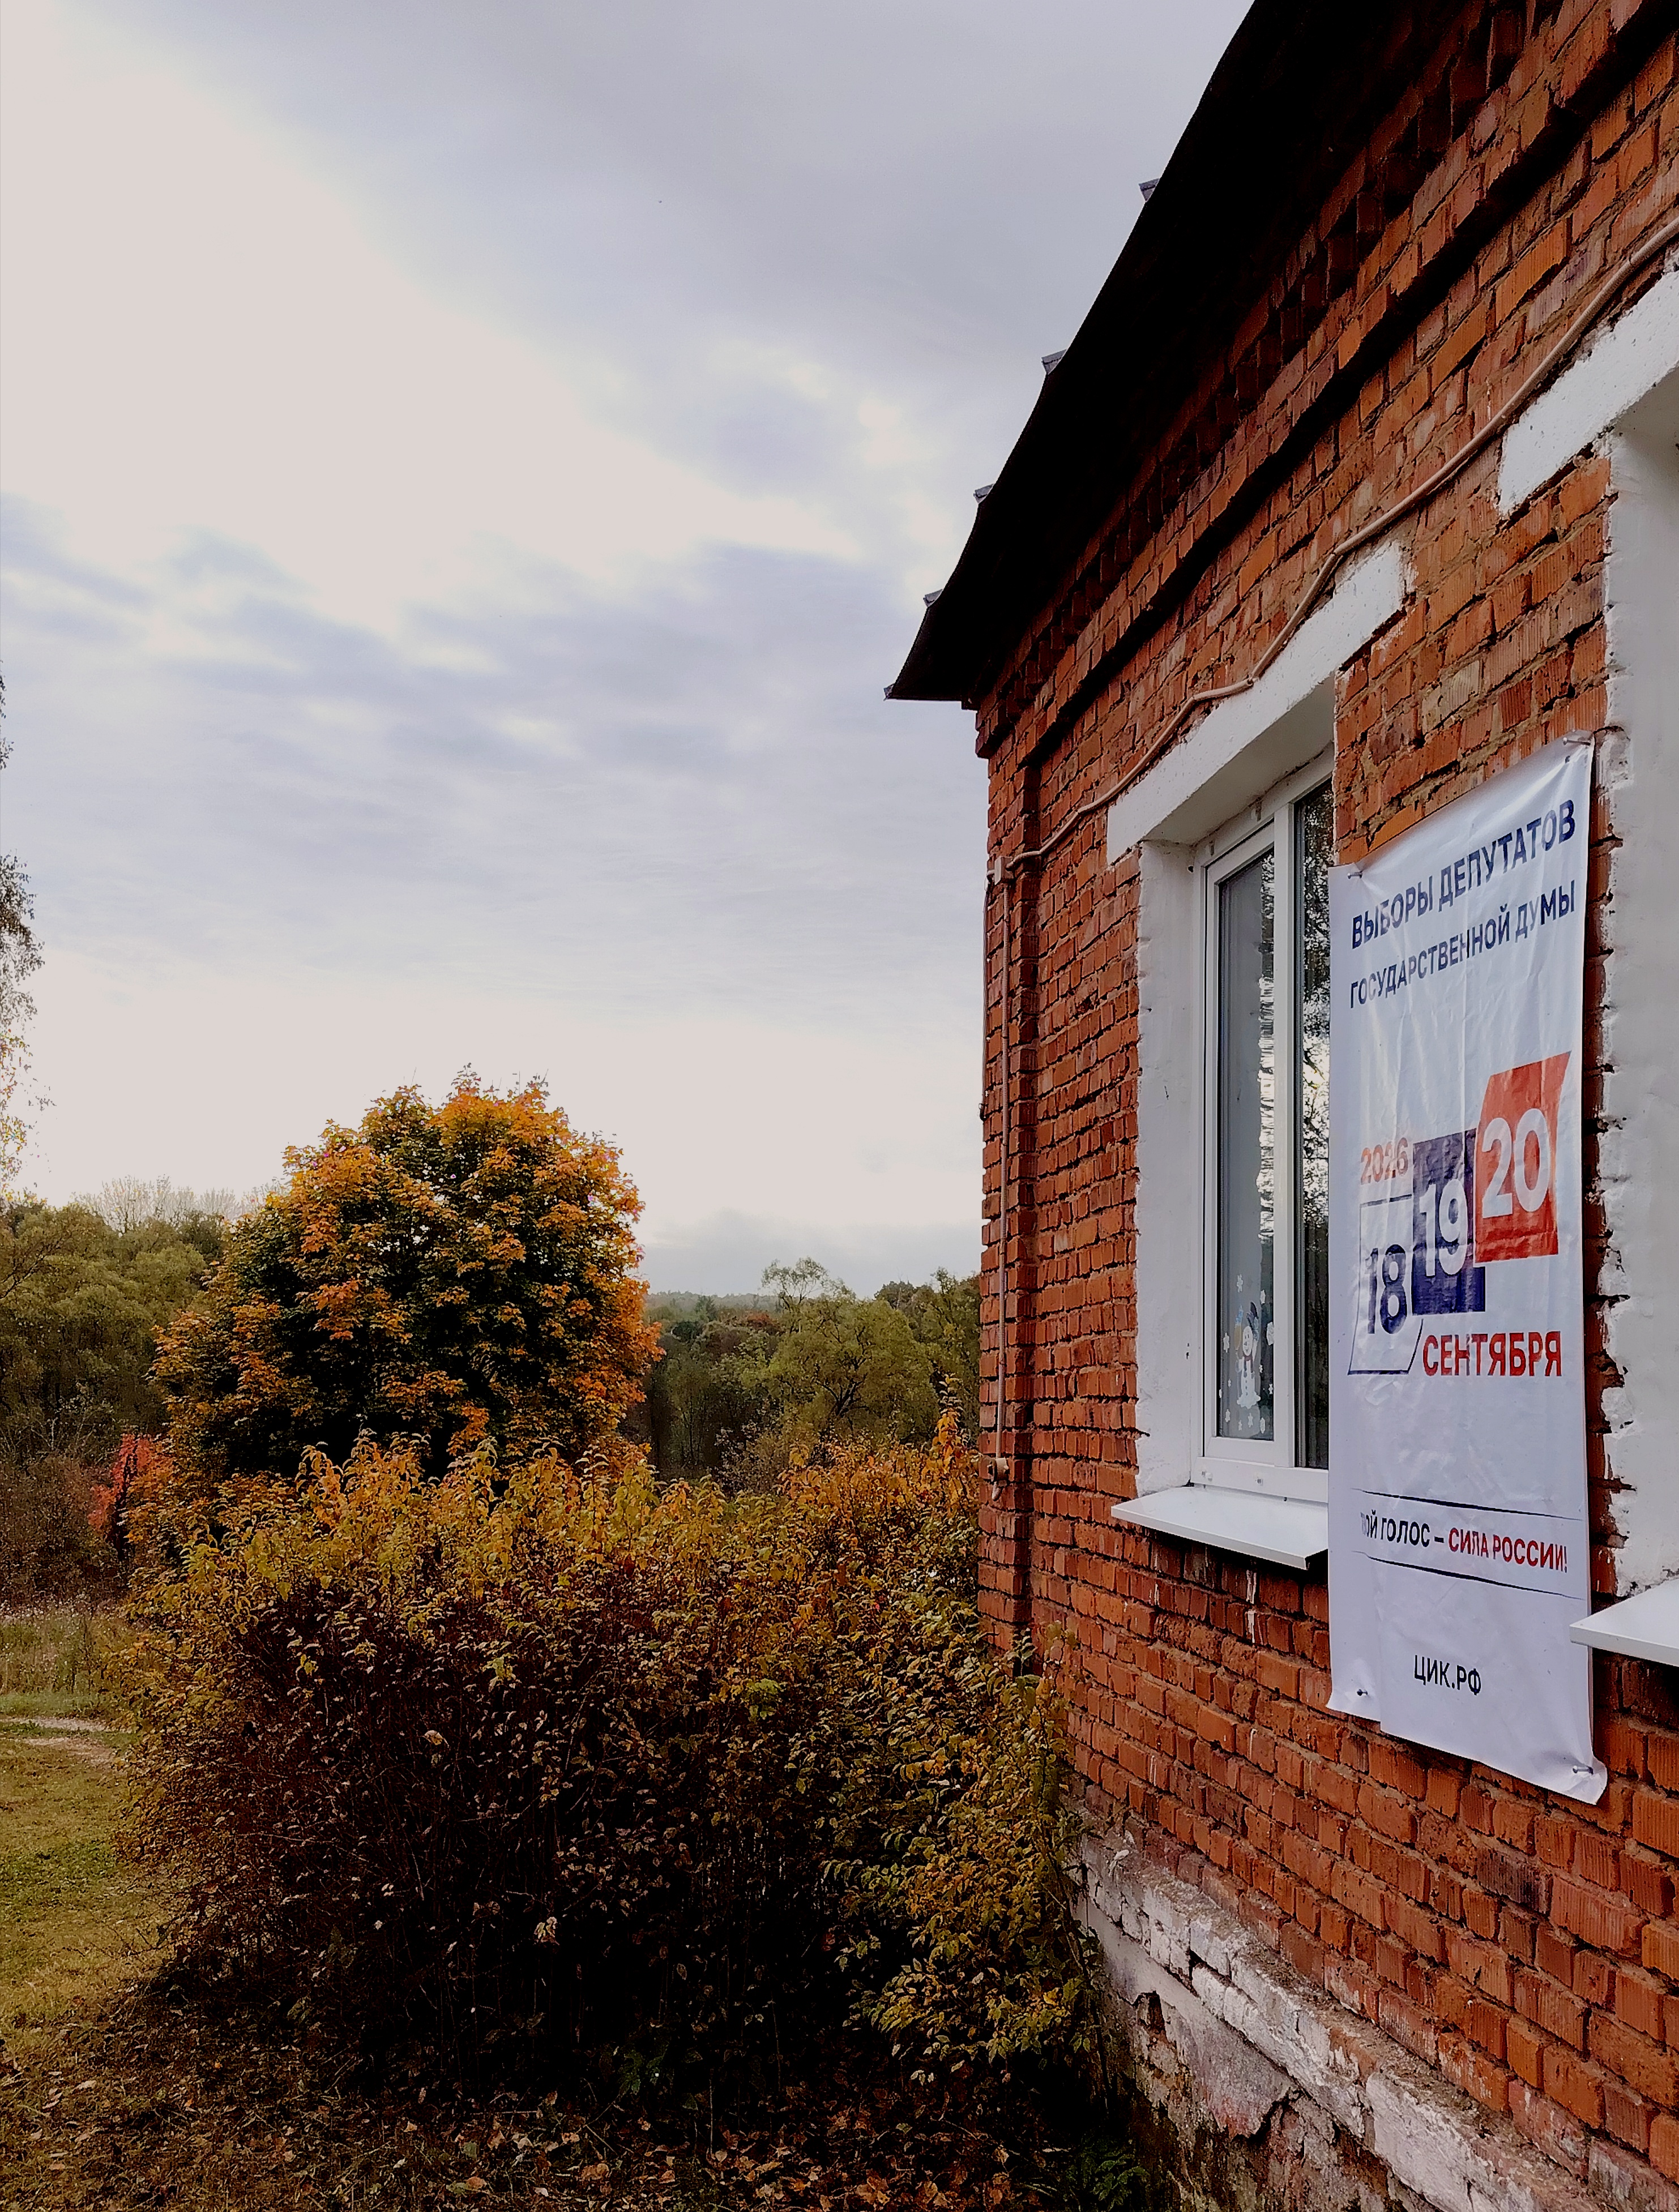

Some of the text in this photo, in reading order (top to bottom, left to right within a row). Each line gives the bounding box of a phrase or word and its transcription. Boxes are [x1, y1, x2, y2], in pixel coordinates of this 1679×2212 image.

[1352, 799, 1576, 949] ВЫБОРЫ ДЕПУТАТОВ
[1350, 880, 1575, 1009] ГОСУДАРСТВЕННОЙ ДУМЫ
[1365, 1107, 1552, 1334] 18 19 20
[1422, 1330, 1562, 1377] СЕНТЯБРЯ
[1380, 1517, 1430, 1547] ГОЛОС
[1449, 1527, 1489, 1558] СИЛА
[1492, 1534, 1567, 1573] РОССИИ!
[1414, 1654, 1481, 1695] ЦИК.РФ
